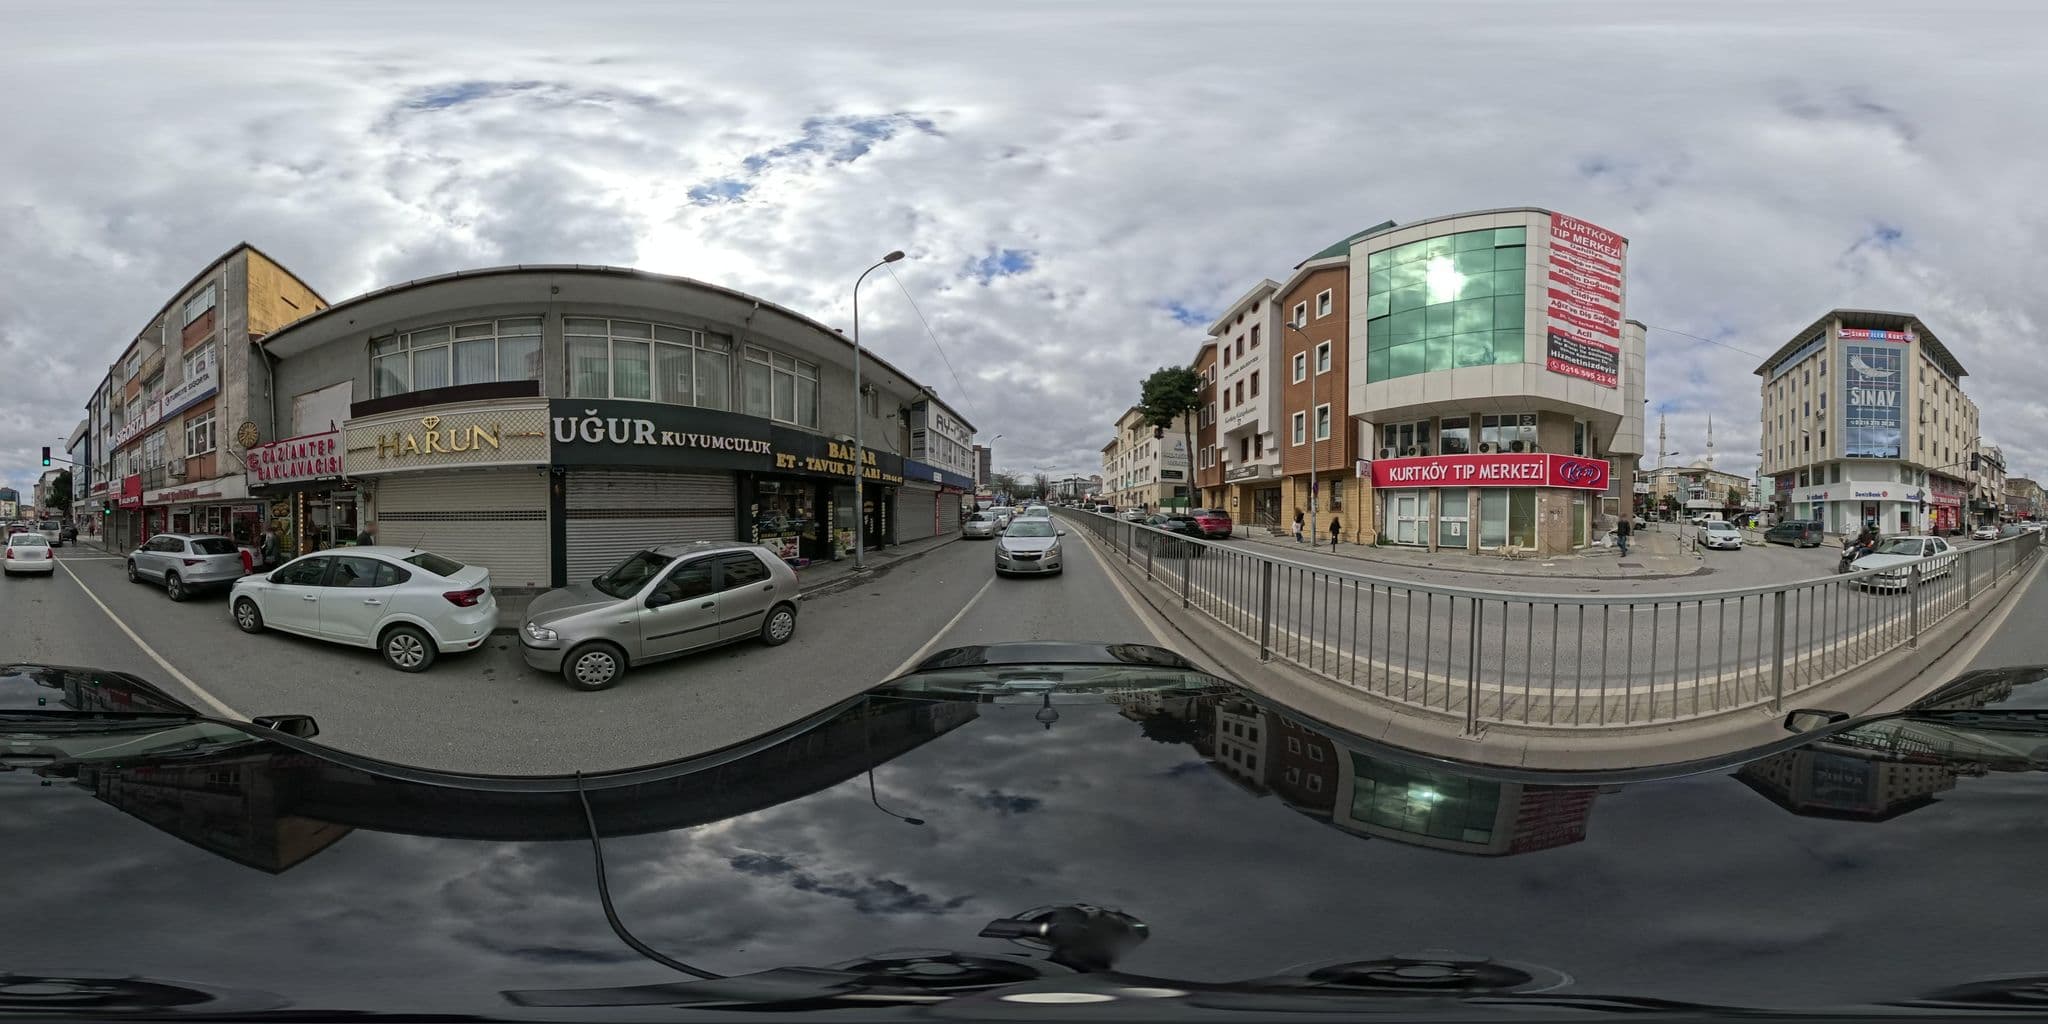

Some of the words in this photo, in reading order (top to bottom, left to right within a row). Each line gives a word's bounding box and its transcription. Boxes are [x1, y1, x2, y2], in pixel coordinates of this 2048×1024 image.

[1552, 226, 1570, 239] TIP
[1571, 289, 1600, 303] Cildiye
[1576, 329, 1592, 339] Acil
[1551, 349, 1617, 375] Hizmetinizdeyiz
[1851, 387, 1896, 407] SINAV
[377, 422, 499, 459] HARUN
[552, 408, 658, 446] UĞUR
[661, 431, 772, 455] KUYUMCULUK
[262, 438, 336, 464] GAZİANTEP
[257, 455, 344, 480] BAKLAVACISI
[776, 452, 797, 469] ET
[805, 456, 846, 475] TAVUK
[1389, 462, 1448, 482] KURTKÖY
[1453, 464, 1475, 480] TIP
[1479, 460, 1544, 480] MERKEZİ
